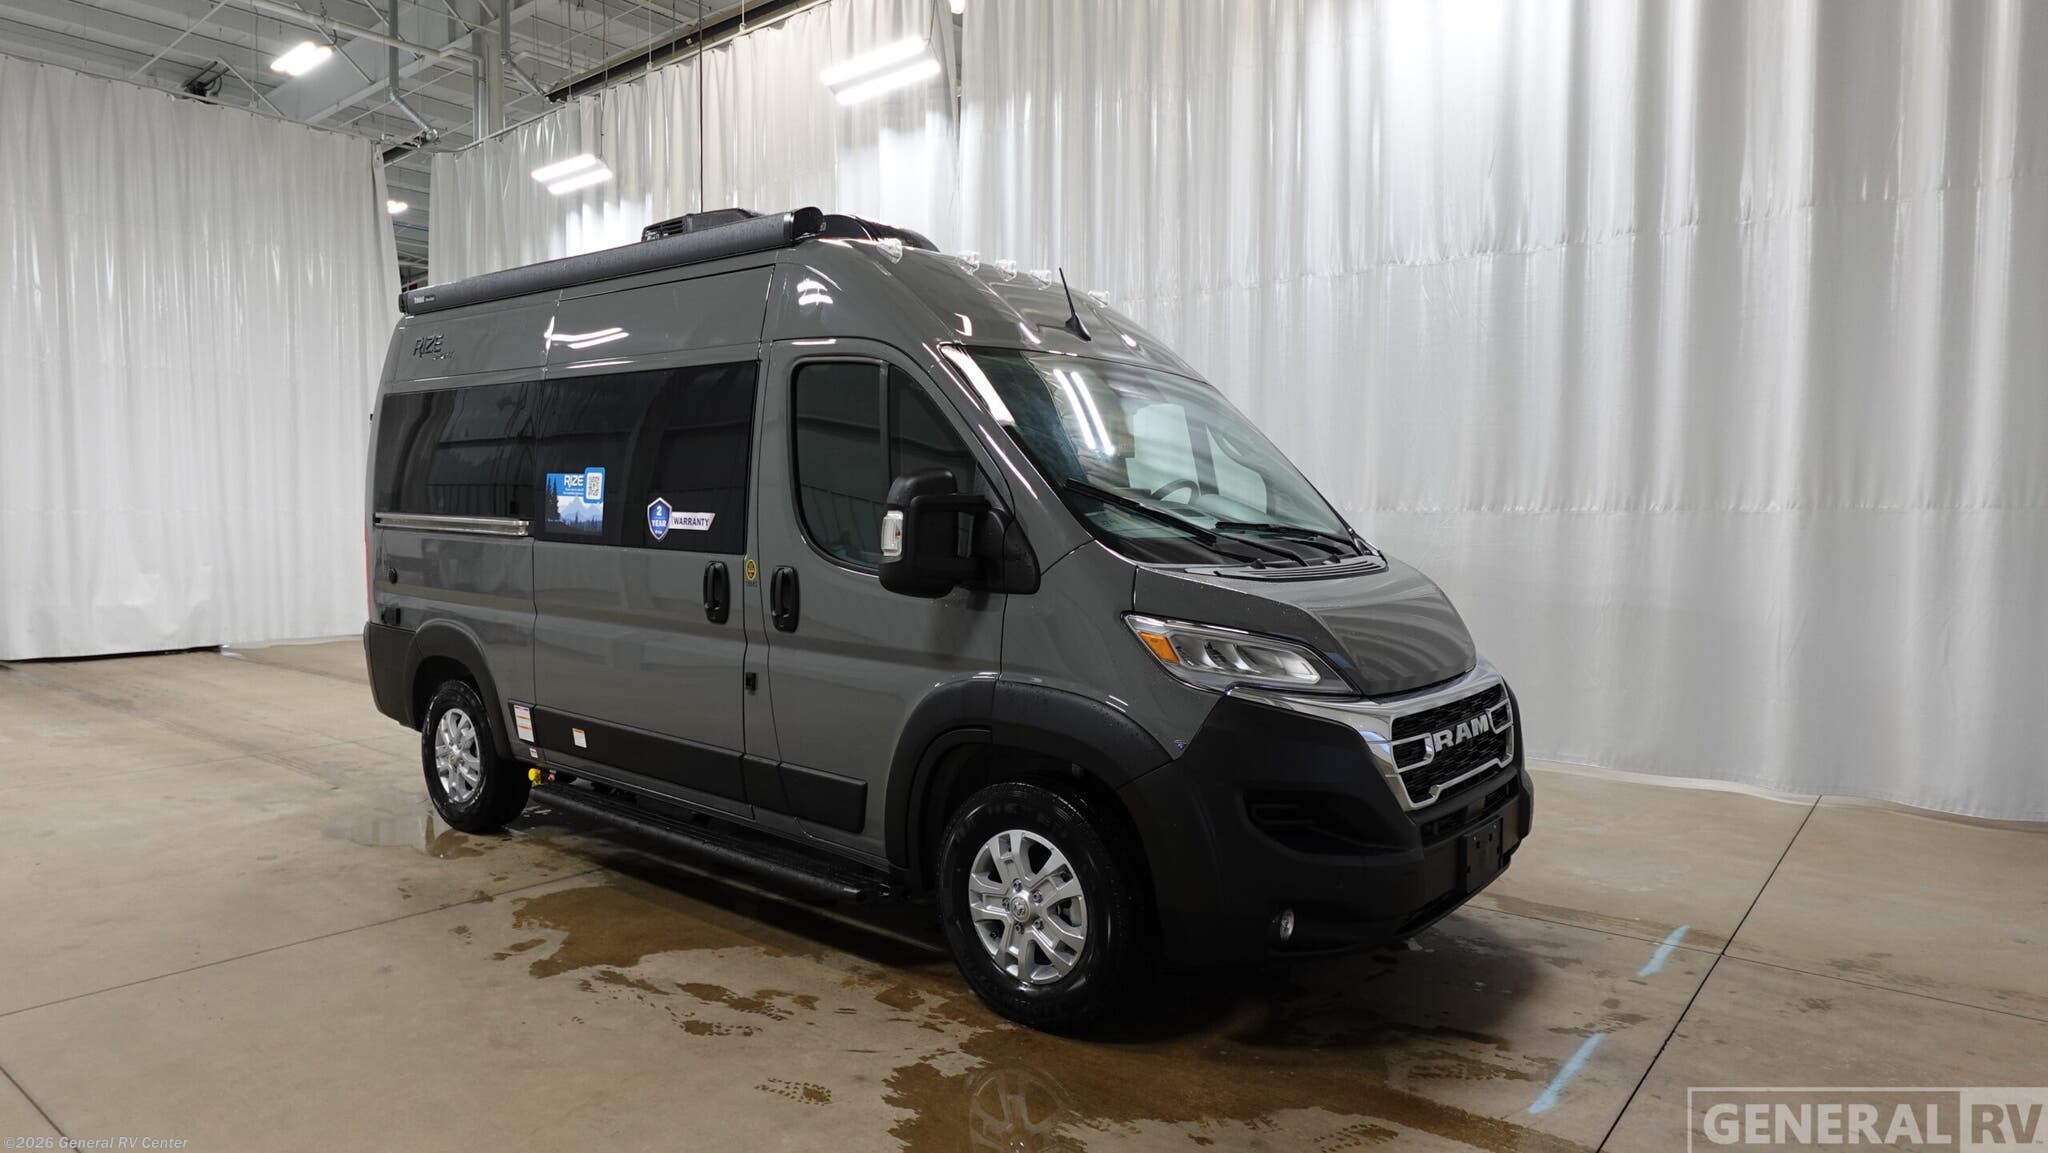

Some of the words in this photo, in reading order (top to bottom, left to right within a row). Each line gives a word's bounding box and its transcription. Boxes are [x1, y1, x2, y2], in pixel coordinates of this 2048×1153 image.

[413, 335, 444, 358] RIZE
[564, 475, 584, 488] RIZE
[656, 505, 663, 516] 2
[651, 519, 667, 527] YEAR
[673, 517, 710, 526] WARRANTY
[1432, 714, 1489, 752] RAM
